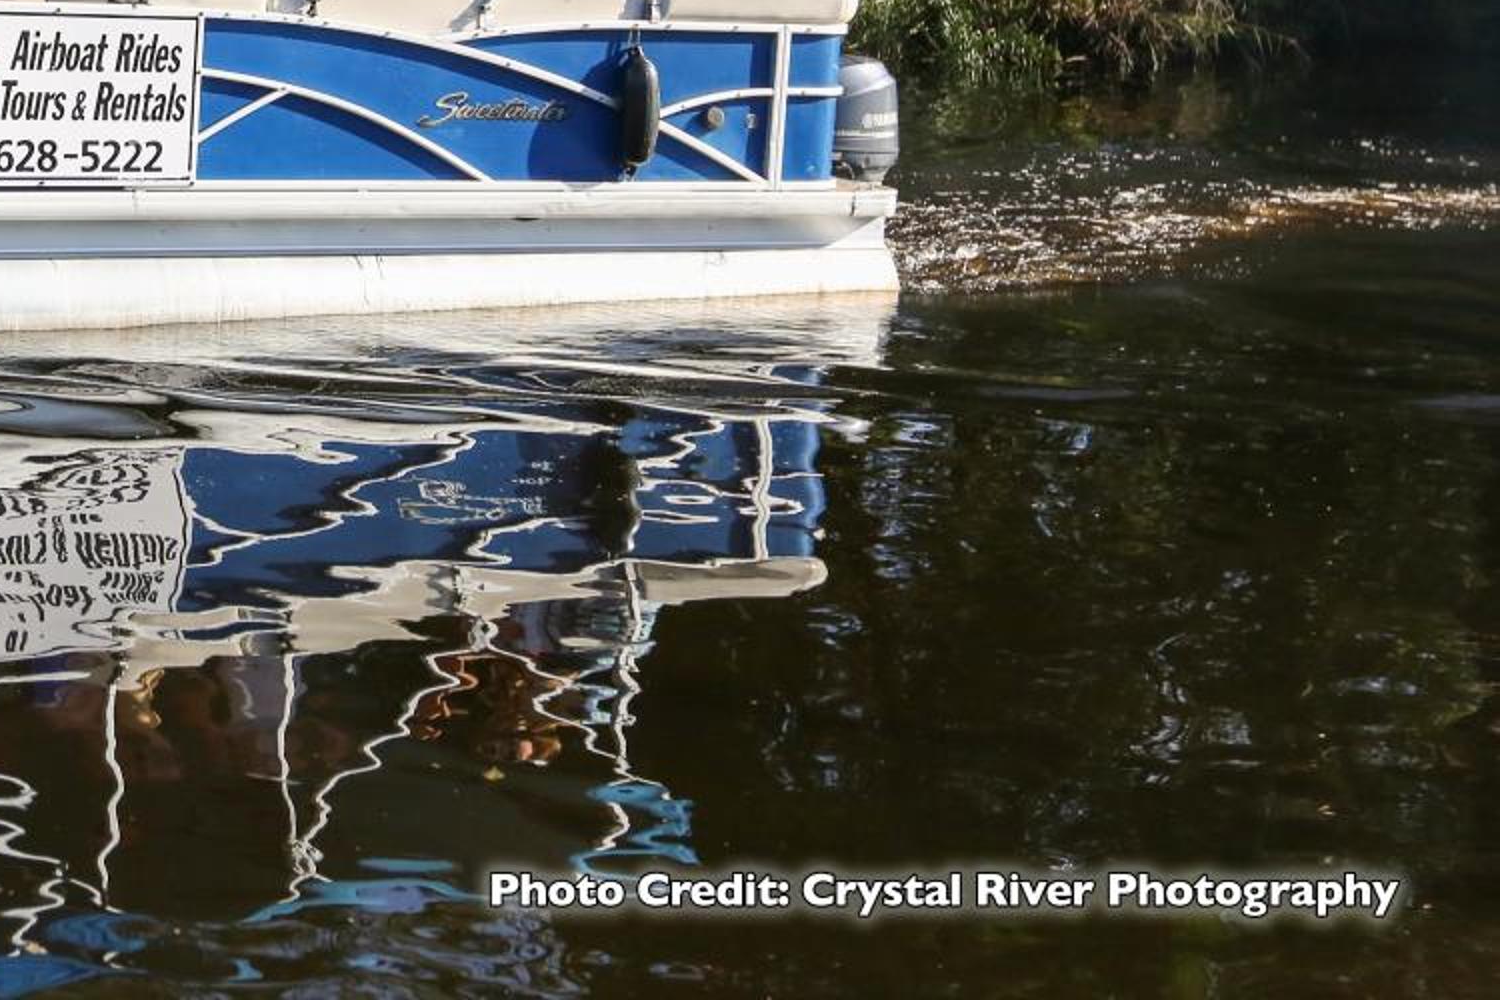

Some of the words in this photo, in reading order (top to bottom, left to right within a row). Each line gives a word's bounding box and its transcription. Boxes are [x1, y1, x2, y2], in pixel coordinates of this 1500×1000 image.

[10, 30, 108, 73] Airboat
[115, 32, 182, 74] Rides
[1, 79, 67, 121] Tours
[71, 90, 87, 121] &
[93, 81, 187, 122] Rentals
